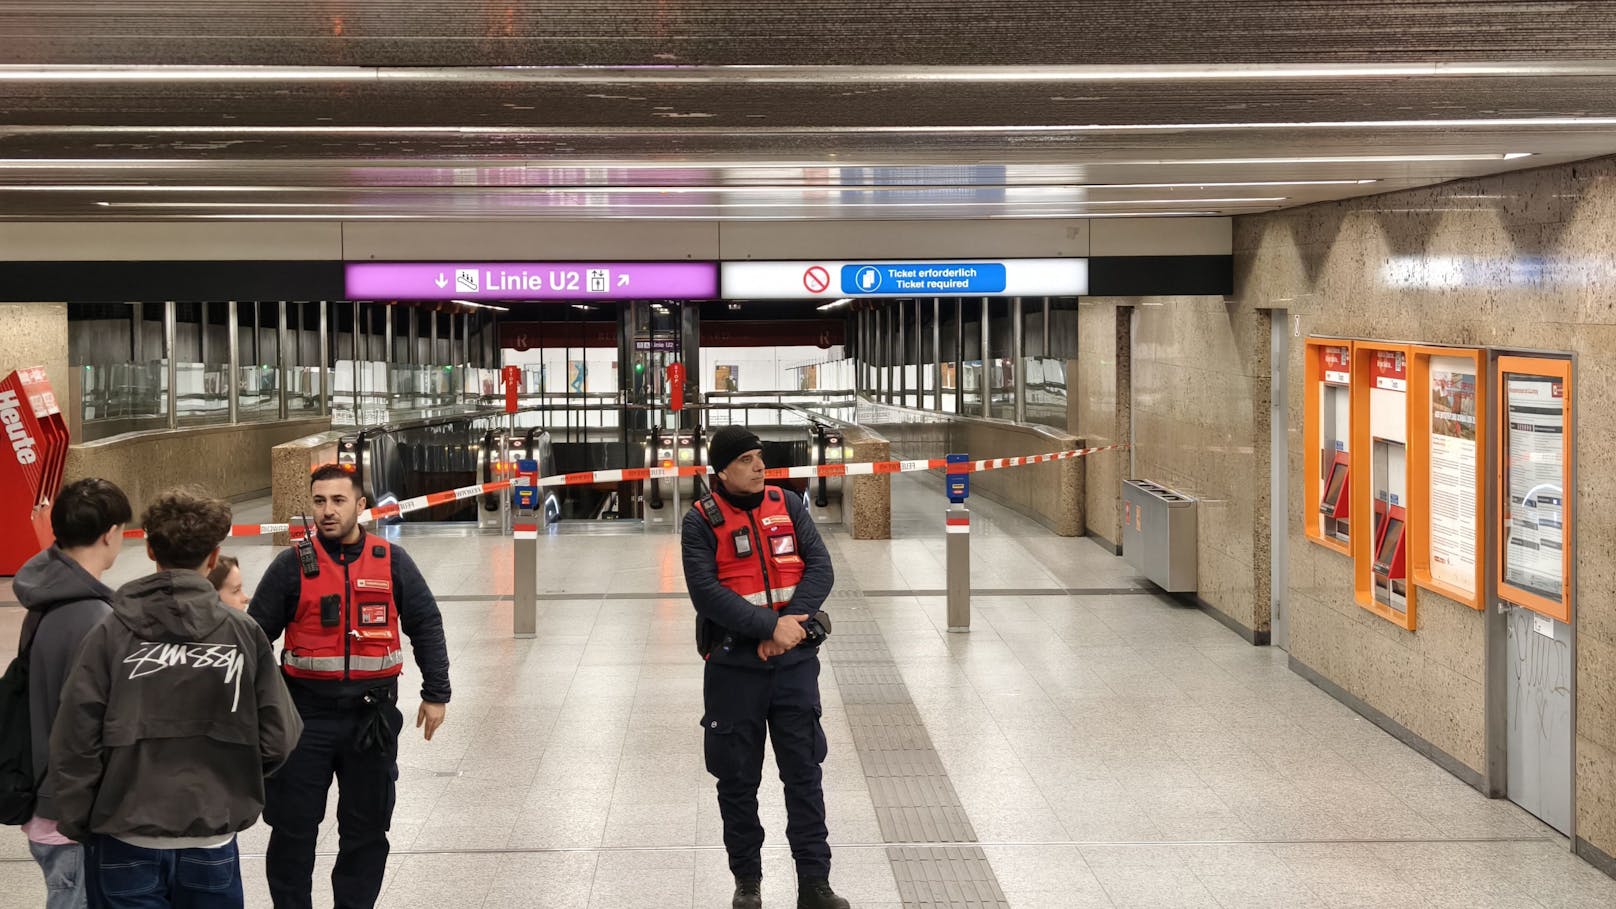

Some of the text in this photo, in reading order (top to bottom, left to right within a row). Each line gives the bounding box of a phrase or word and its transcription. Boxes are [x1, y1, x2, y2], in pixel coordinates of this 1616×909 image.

[485, 271, 580, 290] Linie U2
[888, 268, 977, 278] Ticket erforderlich
[896, 279, 969, 290] Ticket required
[0, 389, 37, 465] Heute
